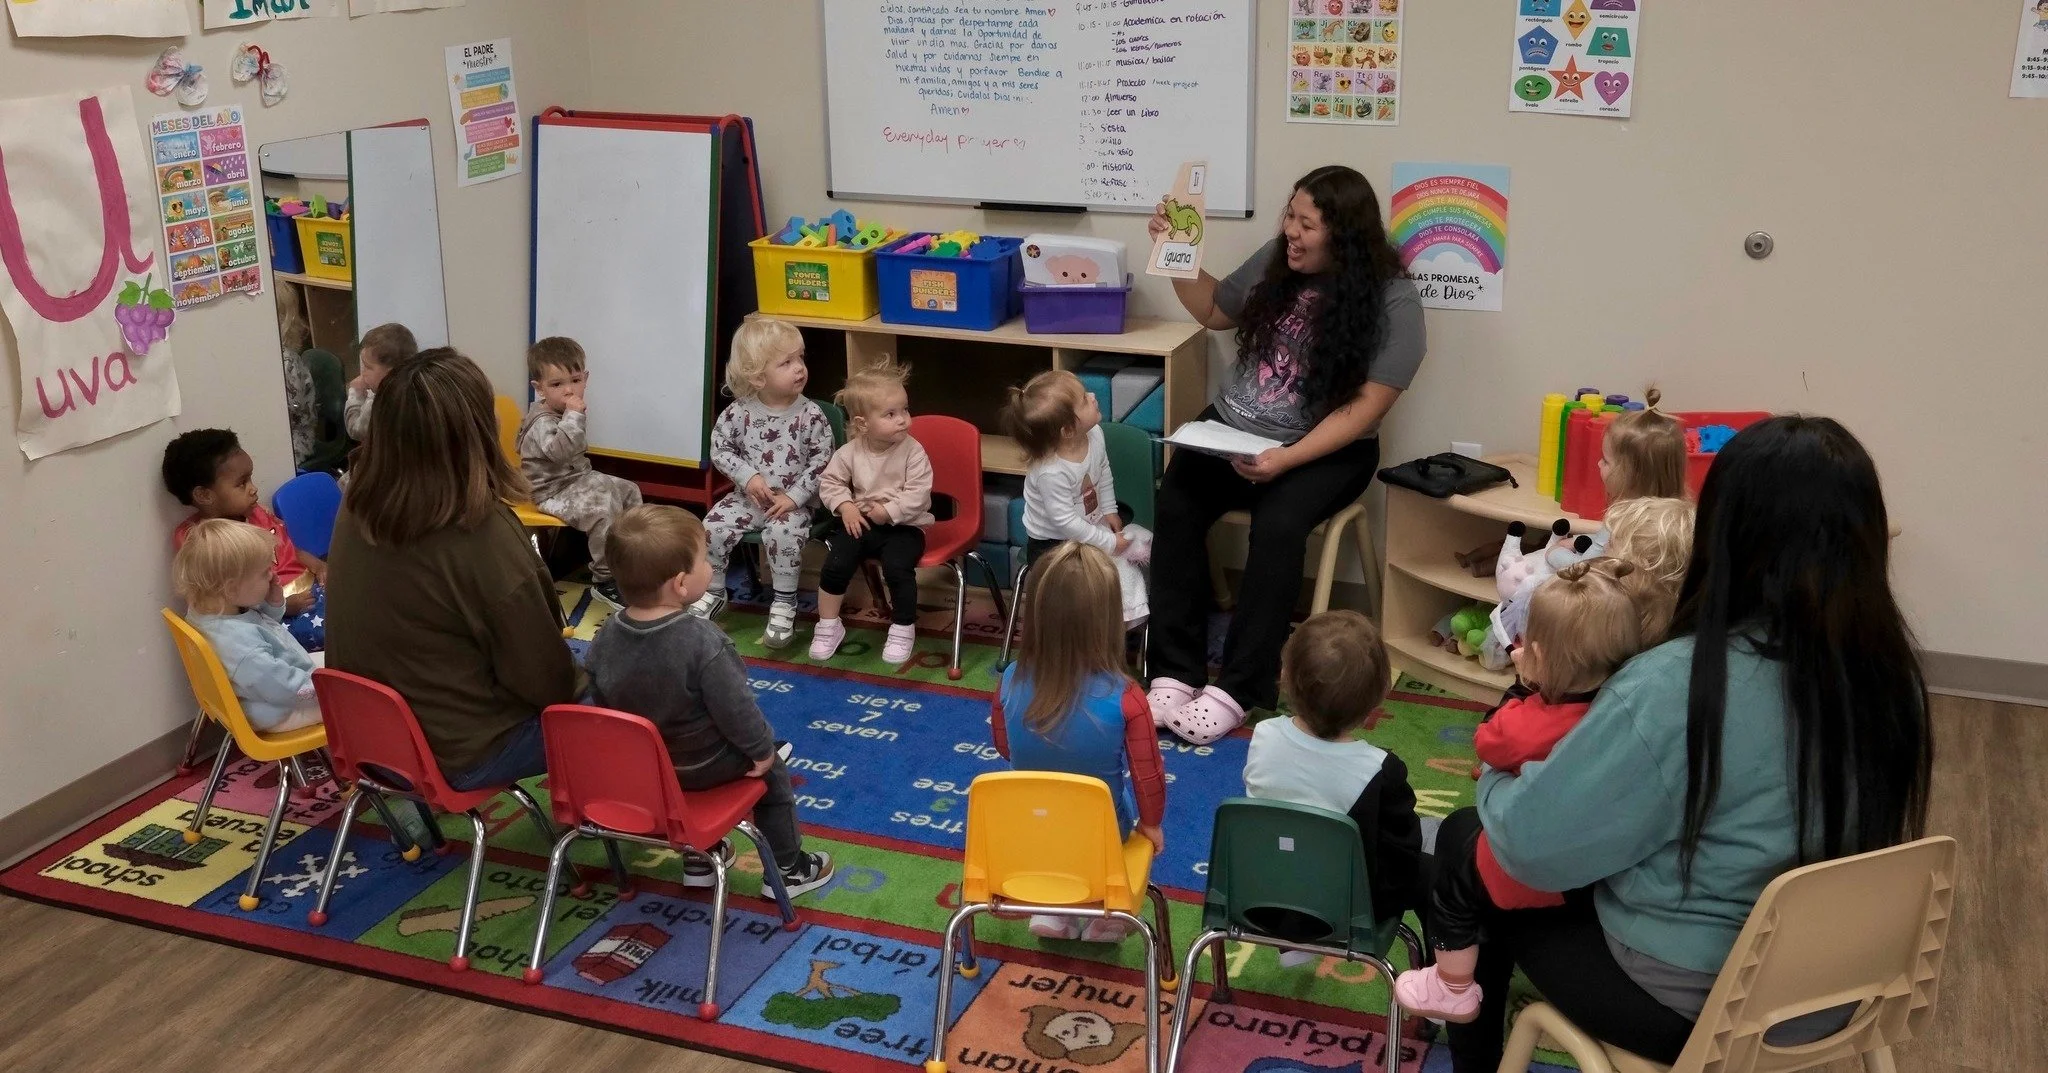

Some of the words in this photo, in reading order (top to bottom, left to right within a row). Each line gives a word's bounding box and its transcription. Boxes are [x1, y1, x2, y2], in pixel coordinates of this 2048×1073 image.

[985, 8, 1020, 16] nombre
[1025, 7, 1046, 16] Amen
[1170, 16, 1183, 24] en
[1186, 10, 1226, 23] rotación
[908, 16, 936, 26] gracias
[941, 18, 955, 28] por
[1019, 19, 1039, 28] cada
[963, 28, 973, 37] la
[1032, 30, 1043, 40] de
[464, 47, 472, 58] EL
[473, 43, 494, 56] PADRE
[973, 39, 1004, 49] Gracias
[1009, 42, 1025, 52] por
[912, 53, 918, 63] y
[923, 53, 937, 63] por
[1026, 54, 1040, 62] en
[930, 62, 951, 74] vidas
[957, 67, 963, 79] y
[1017, 67, 1051, 78] Bendice
[1056, 70, 1063, 79] a
[899, 76, 911, 84] mi
[951, 80, 982, 91] amigos
[984, 80, 990, 91] y
[992, 81, 999, 89] a
[1019, 81, 1039, 90] seres
[994, 92, 1011, 102] Dios
[930, 103, 959, 116] Amen
[1126, 108, 1136, 117] un
[1141, 107, 1160, 118] Libro
[152, 115, 191, 135] MESES
[192, 113, 215, 129] DEL
[216, 109, 241, 126] AÑO
[212, 141, 242, 152] febrero
[883, 126, 949, 154] Everyday
[173, 149, 197, 160] enero
[227, 168, 246, 180] abril
[176, 178, 202, 189] marzo
[1414, 182, 1429, 191] DIOS
[1430, 179, 1438, 187] ES
[1440, 178, 1466, 187] SIEMPRE
[1466, 181, 1480, 191] FIEL
[1430, 187, 1450, 197] NUNCA
[229, 196, 249, 211] junio
[185, 206, 207, 217] mayo
[1408, 212, 1422, 225] DIOS
[1423, 206, 1448, 217] CUMPLE
[1450, 206, 1461, 214] SUS
[1462, 207, 1493, 229] PROMESAS
[1418, 219, 1434, 229] DIOS
[228, 226, 254, 239] agosto
[1418, 228, 1433, 239] DIOS
[193, 235, 211, 248] julio
[1413, 243, 1425, 253] DIOS
[1451, 236, 1465, 244] PARA
[228, 254, 257, 267] octubre
[1164, 249, 1192, 268] iguana
[173, 263, 217, 280] septiembre
[793, 271, 821, 280] TOWER
[788, 278, 828, 287] BUILDERS
[922, 280, 945, 289] FISH
[1412, 273, 1429, 282] LAS
[1431, 274, 1480, 285] PROMESAS
[912, 286, 956, 297] BUILDERS
[1420, 284, 1439, 299] de
[1443, 285, 1476, 301] Dios
[176, 291, 220, 307] noviembre
[36, 352, 138, 419] uva
[847, 693, 922, 713] siete
[859, 710, 882, 724] 7
[807, 719, 899, 742] seven
[890, 811, 964, 834] tres
[55, 855, 166, 889] school
[810, 934, 928, 976] árbol
[1008, 973, 1138, 1011] mujer
[834, 1021, 932, 1058] tree
[1207, 1010, 1375, 1058] pájaro
